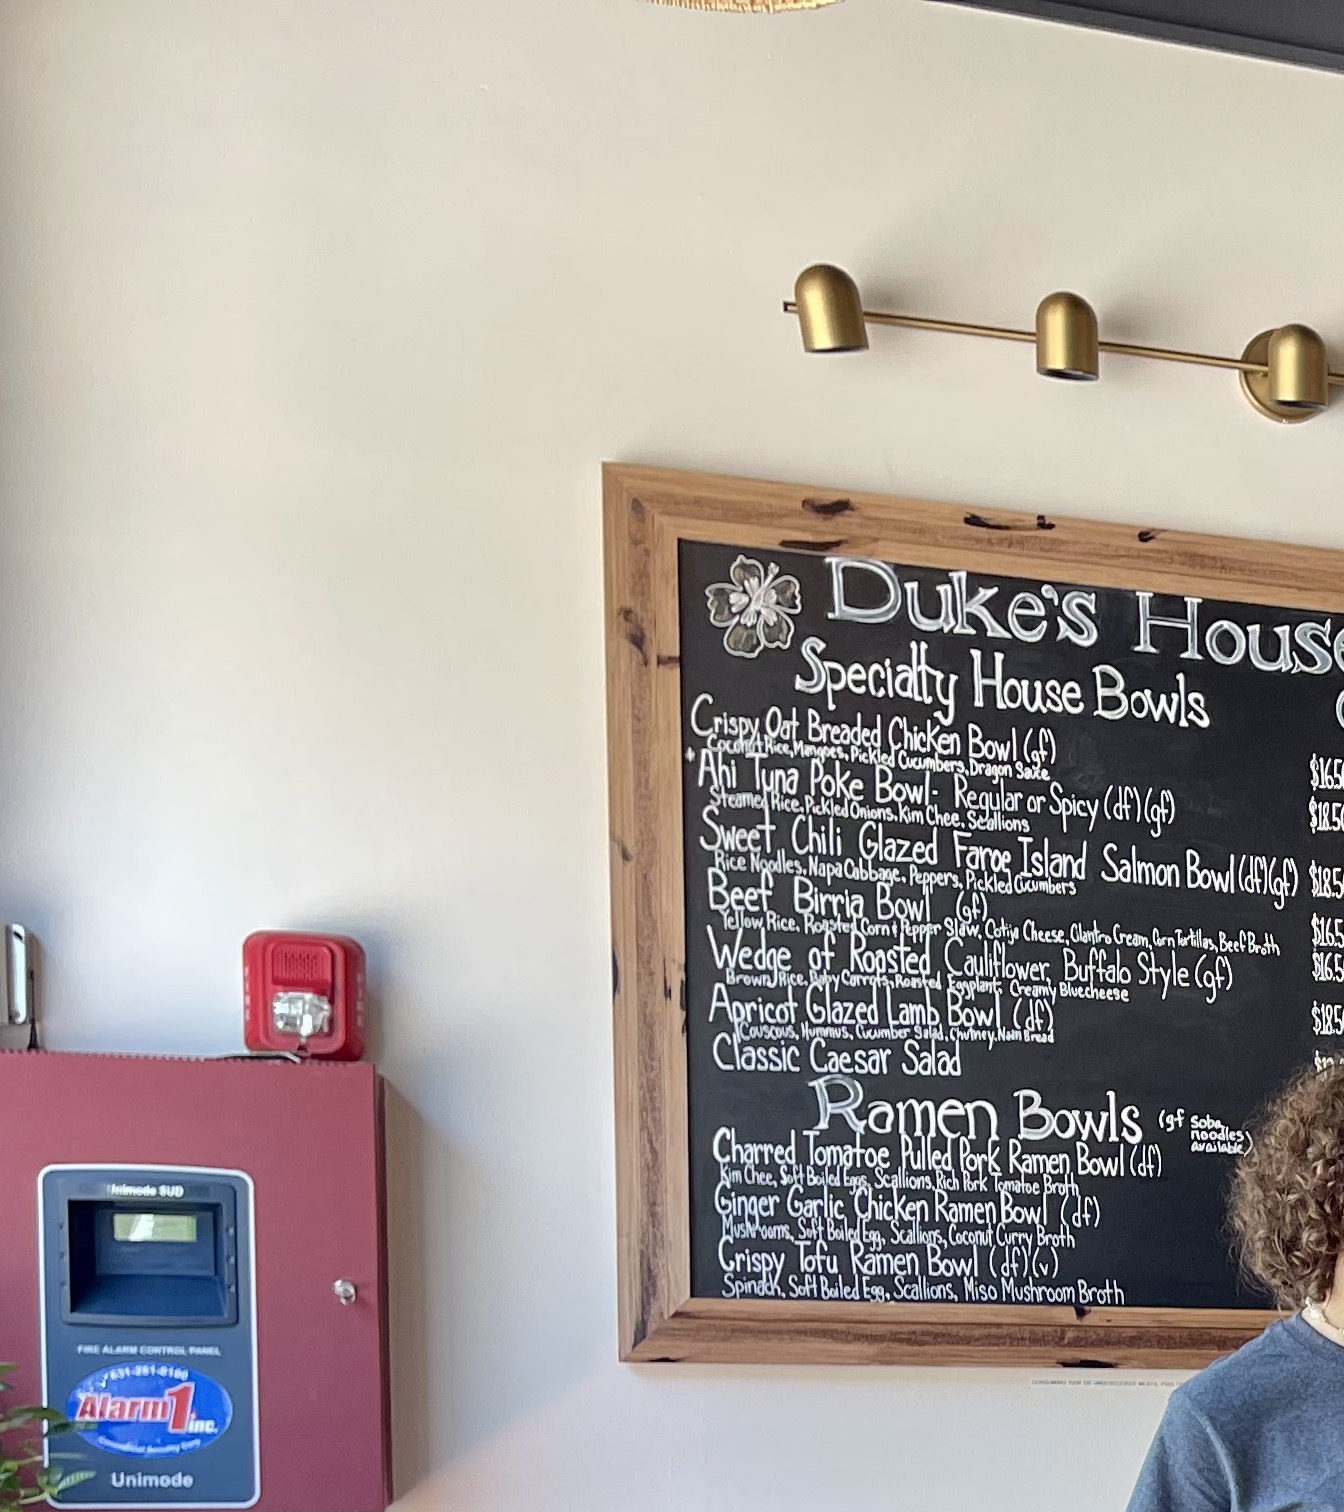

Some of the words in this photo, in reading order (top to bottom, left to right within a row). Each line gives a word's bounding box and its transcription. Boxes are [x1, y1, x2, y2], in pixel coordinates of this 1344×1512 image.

[825, 556, 1098, 647] Duke's
[795, 637, 958, 726] Specialty
[970, 648, 1085, 714] House
[1092, 665, 1210, 728] Bowls
[691, 694, 760, 744] Crispy
[765, 706, 799, 740] Oat
[807, 709, 881, 749] Breaded
[889, 716, 960, 756] Chicken
[968, 723, 1017, 760] Bowl
[699, 747, 736, 789] Ahi
[810, 761, 864, 801] Poke
[954, 772, 1023, 818] Regular
[1027, 794, 1046, 814] or
[1049, 781, 1098, 833] Spicy
[700, 805, 776, 853] Sweet
[792, 815, 841, 856] Chili
[860, 821, 938, 865] Glazed
[953, 829, 1012, 876] Faroe
[1018, 836, 1087, 880] Island
[1101, 843, 1180, 887] Salmon
[1186, 849, 1235, 894] Bowl
[707, 867, 774, 911] Beef
[794, 876, 864, 920] Birria
[876, 881, 930, 922] Bowl
[707, 924, 791, 980] Wedge
[809, 930, 835, 971] of
[850, 930, 930, 975] Roasted
[1063, 947, 1131, 985] Buffalo
[1139, 951, 1190, 1000] Style
[708, 982, 798, 1036] Apricot
[806, 980, 878, 1026] Glazed
[887, 984, 939, 1026] Lamb
[947, 986, 1000, 1028] Bowl
[712, 1032, 800, 1071] Classic
[810, 1033, 892, 1075] Caesar
[901, 1040, 962, 1076] Salad
[808, 1074, 999, 1141] Ramen
[1014, 1089, 1142, 1144] Bowls
[713, 1127, 796, 1165] Charred
[900, 1134, 952, 1172] Pulled
[960, 1135, 1000, 1175] Pork
[1009, 1139, 1070, 1175] Ramen
[1076, 1142, 1125, 1177] Bowl
[715, 1180, 780, 1227] Ginger
[787, 1183, 845, 1220] Garlic
[854, 1185, 928, 1221] Chicken
[935, 1187, 996, 1224] Ramen
[1000, 1190, 1046, 1226] Bowl
[718, 1236, 784, 1280] Crispy
[795, 1239, 838, 1274] Tofu
[850, 1239, 919, 1276] Ramen
[927, 1243, 978, 1278] Bowl
[1001, 1278, 1074, 1304] Mushroom
[1078, 1279, 1125, 1305] Broth
[77, 1344, 99, 1355] FIRE
[102, 1344, 138, 1355] ALARM
[140, 1345, 188, 1356] CONTROL
[189, 1346, 221, 1356] PANEL
[111, 1471, 194, 1489] Unimode
